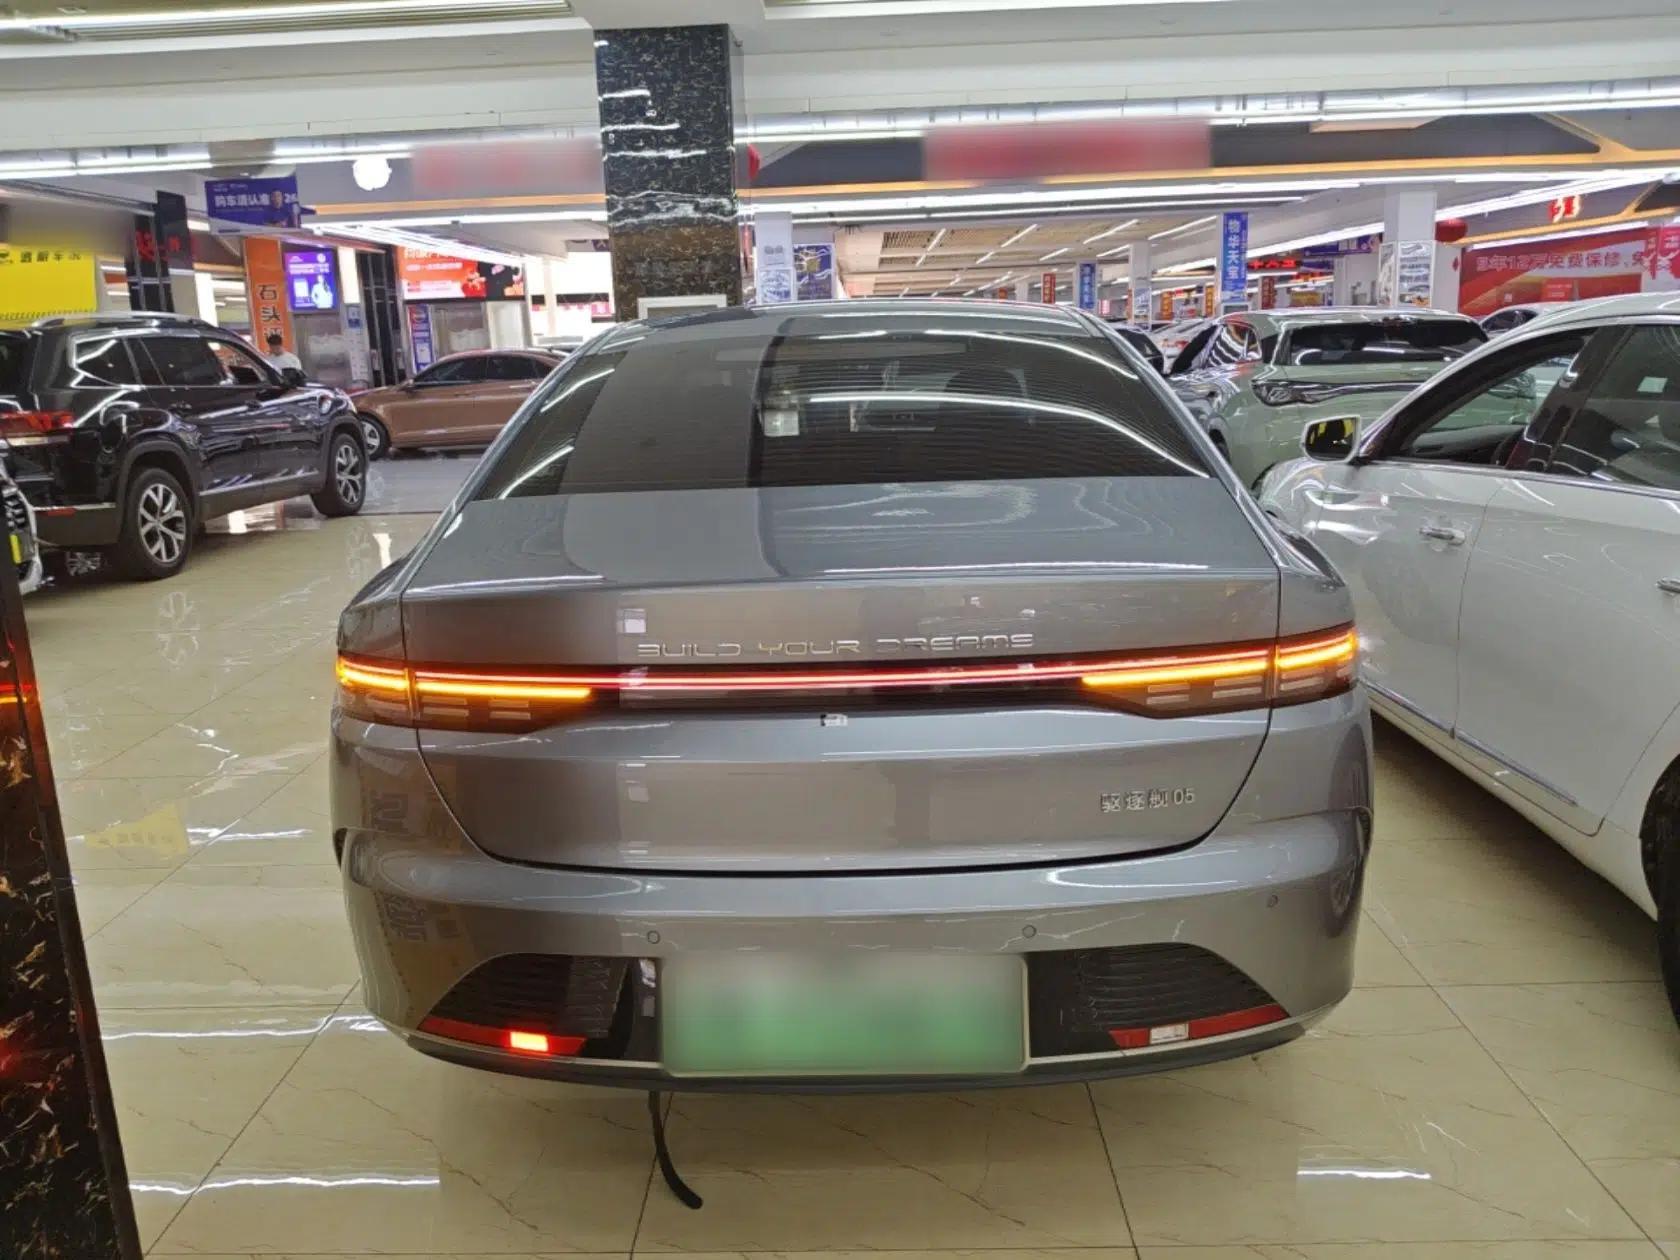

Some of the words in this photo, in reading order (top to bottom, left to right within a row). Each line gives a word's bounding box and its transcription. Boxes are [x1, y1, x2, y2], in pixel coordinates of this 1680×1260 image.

[637, 643, 742, 657] BUILD
[758, 639, 861, 656] YOUR
[875, 634, 1034, 652] DREAMS
